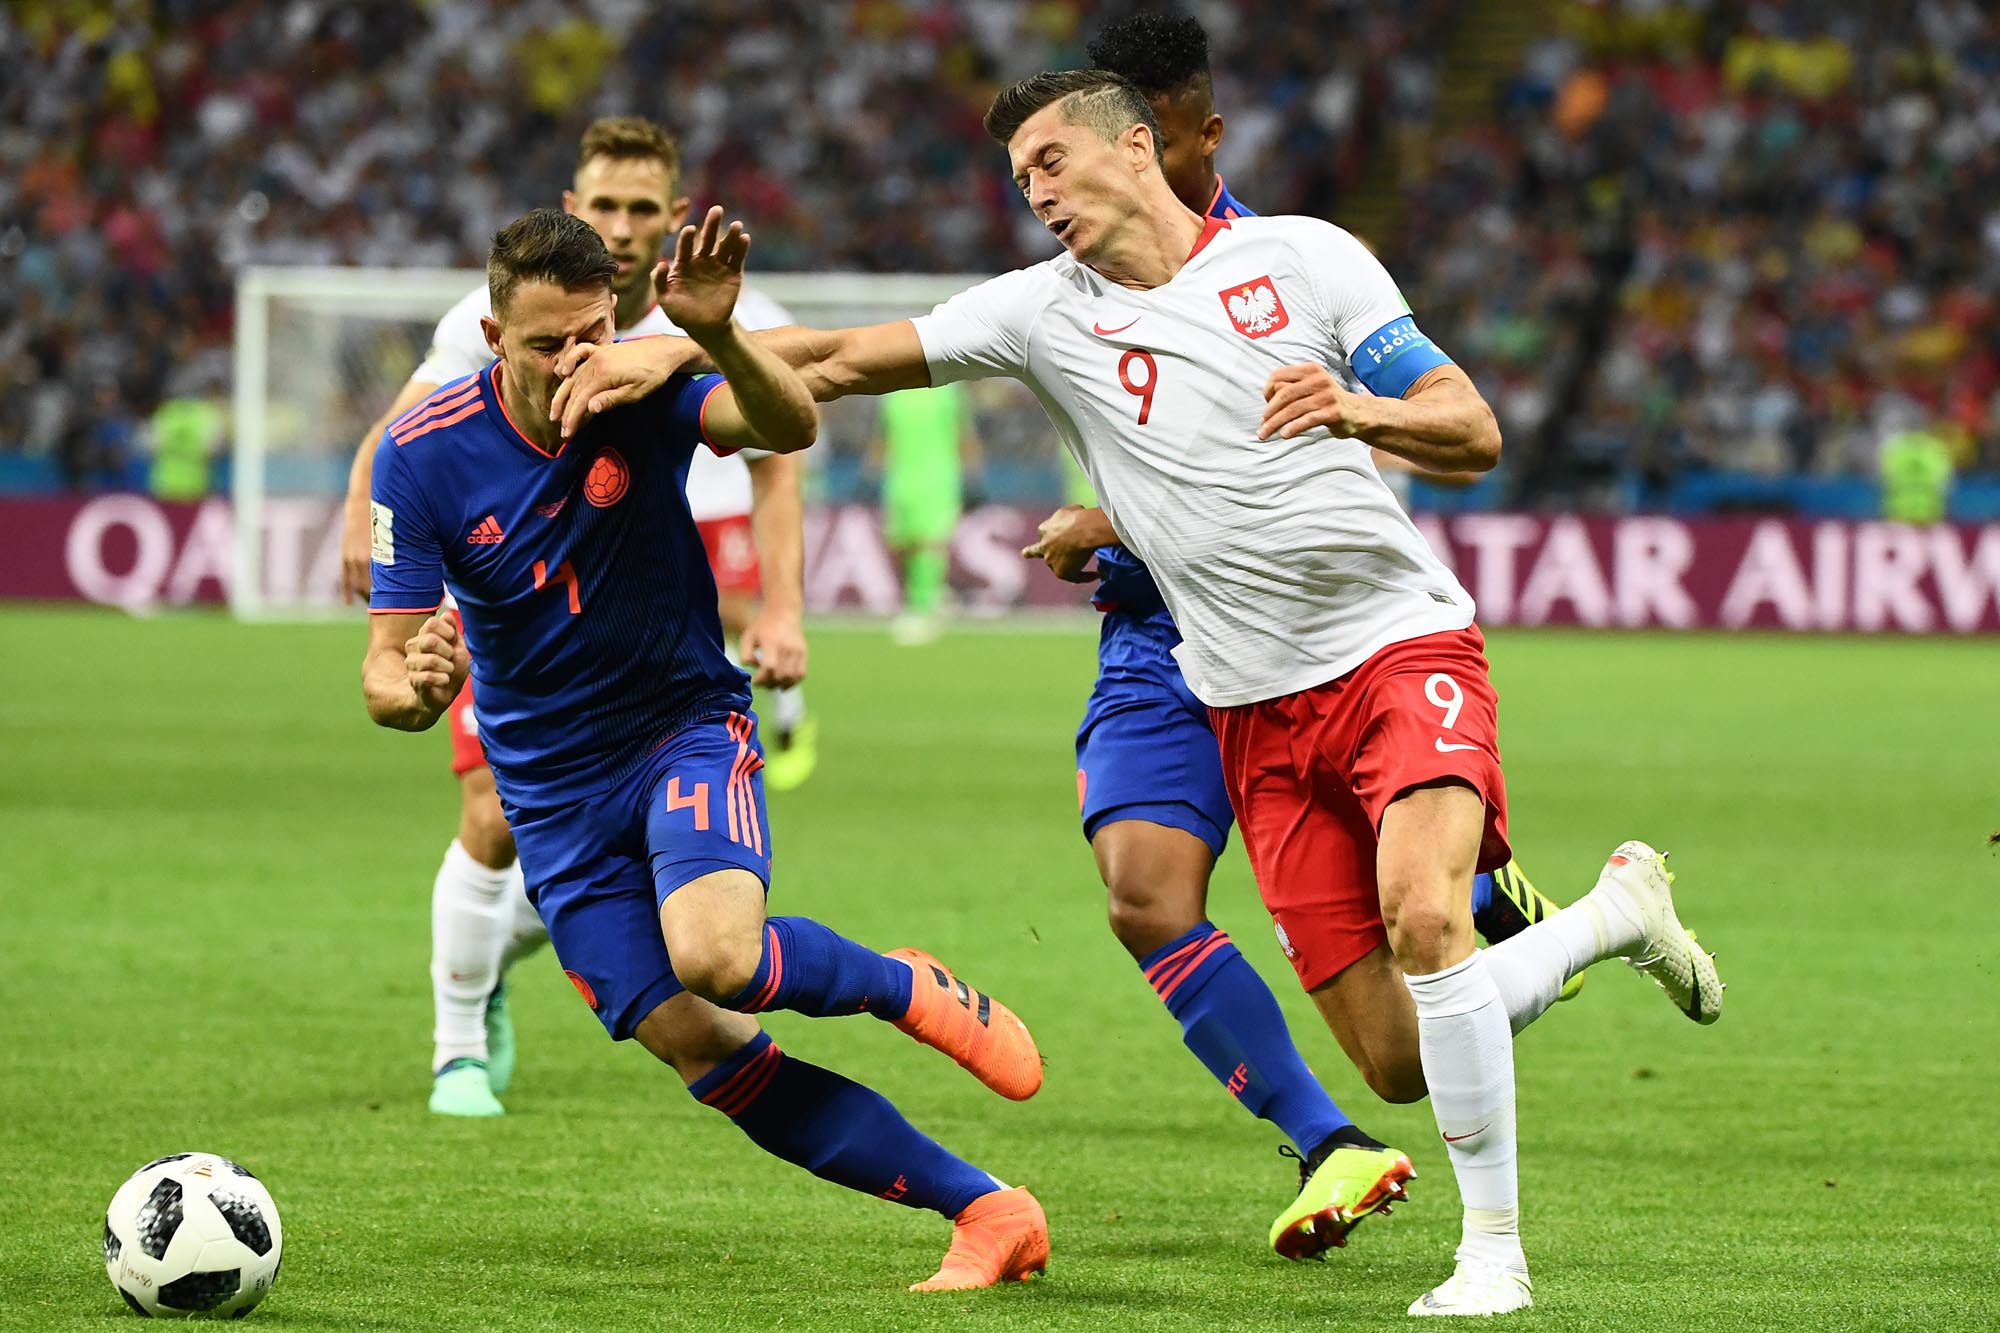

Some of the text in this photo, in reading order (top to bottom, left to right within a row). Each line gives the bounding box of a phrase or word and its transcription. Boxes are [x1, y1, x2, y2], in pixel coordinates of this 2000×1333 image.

[1118, 347, 1158, 426] 9
[532, 559, 582, 614] 4
[1424, 672, 1464, 730] 9
[666, 776, 710, 831] 4
